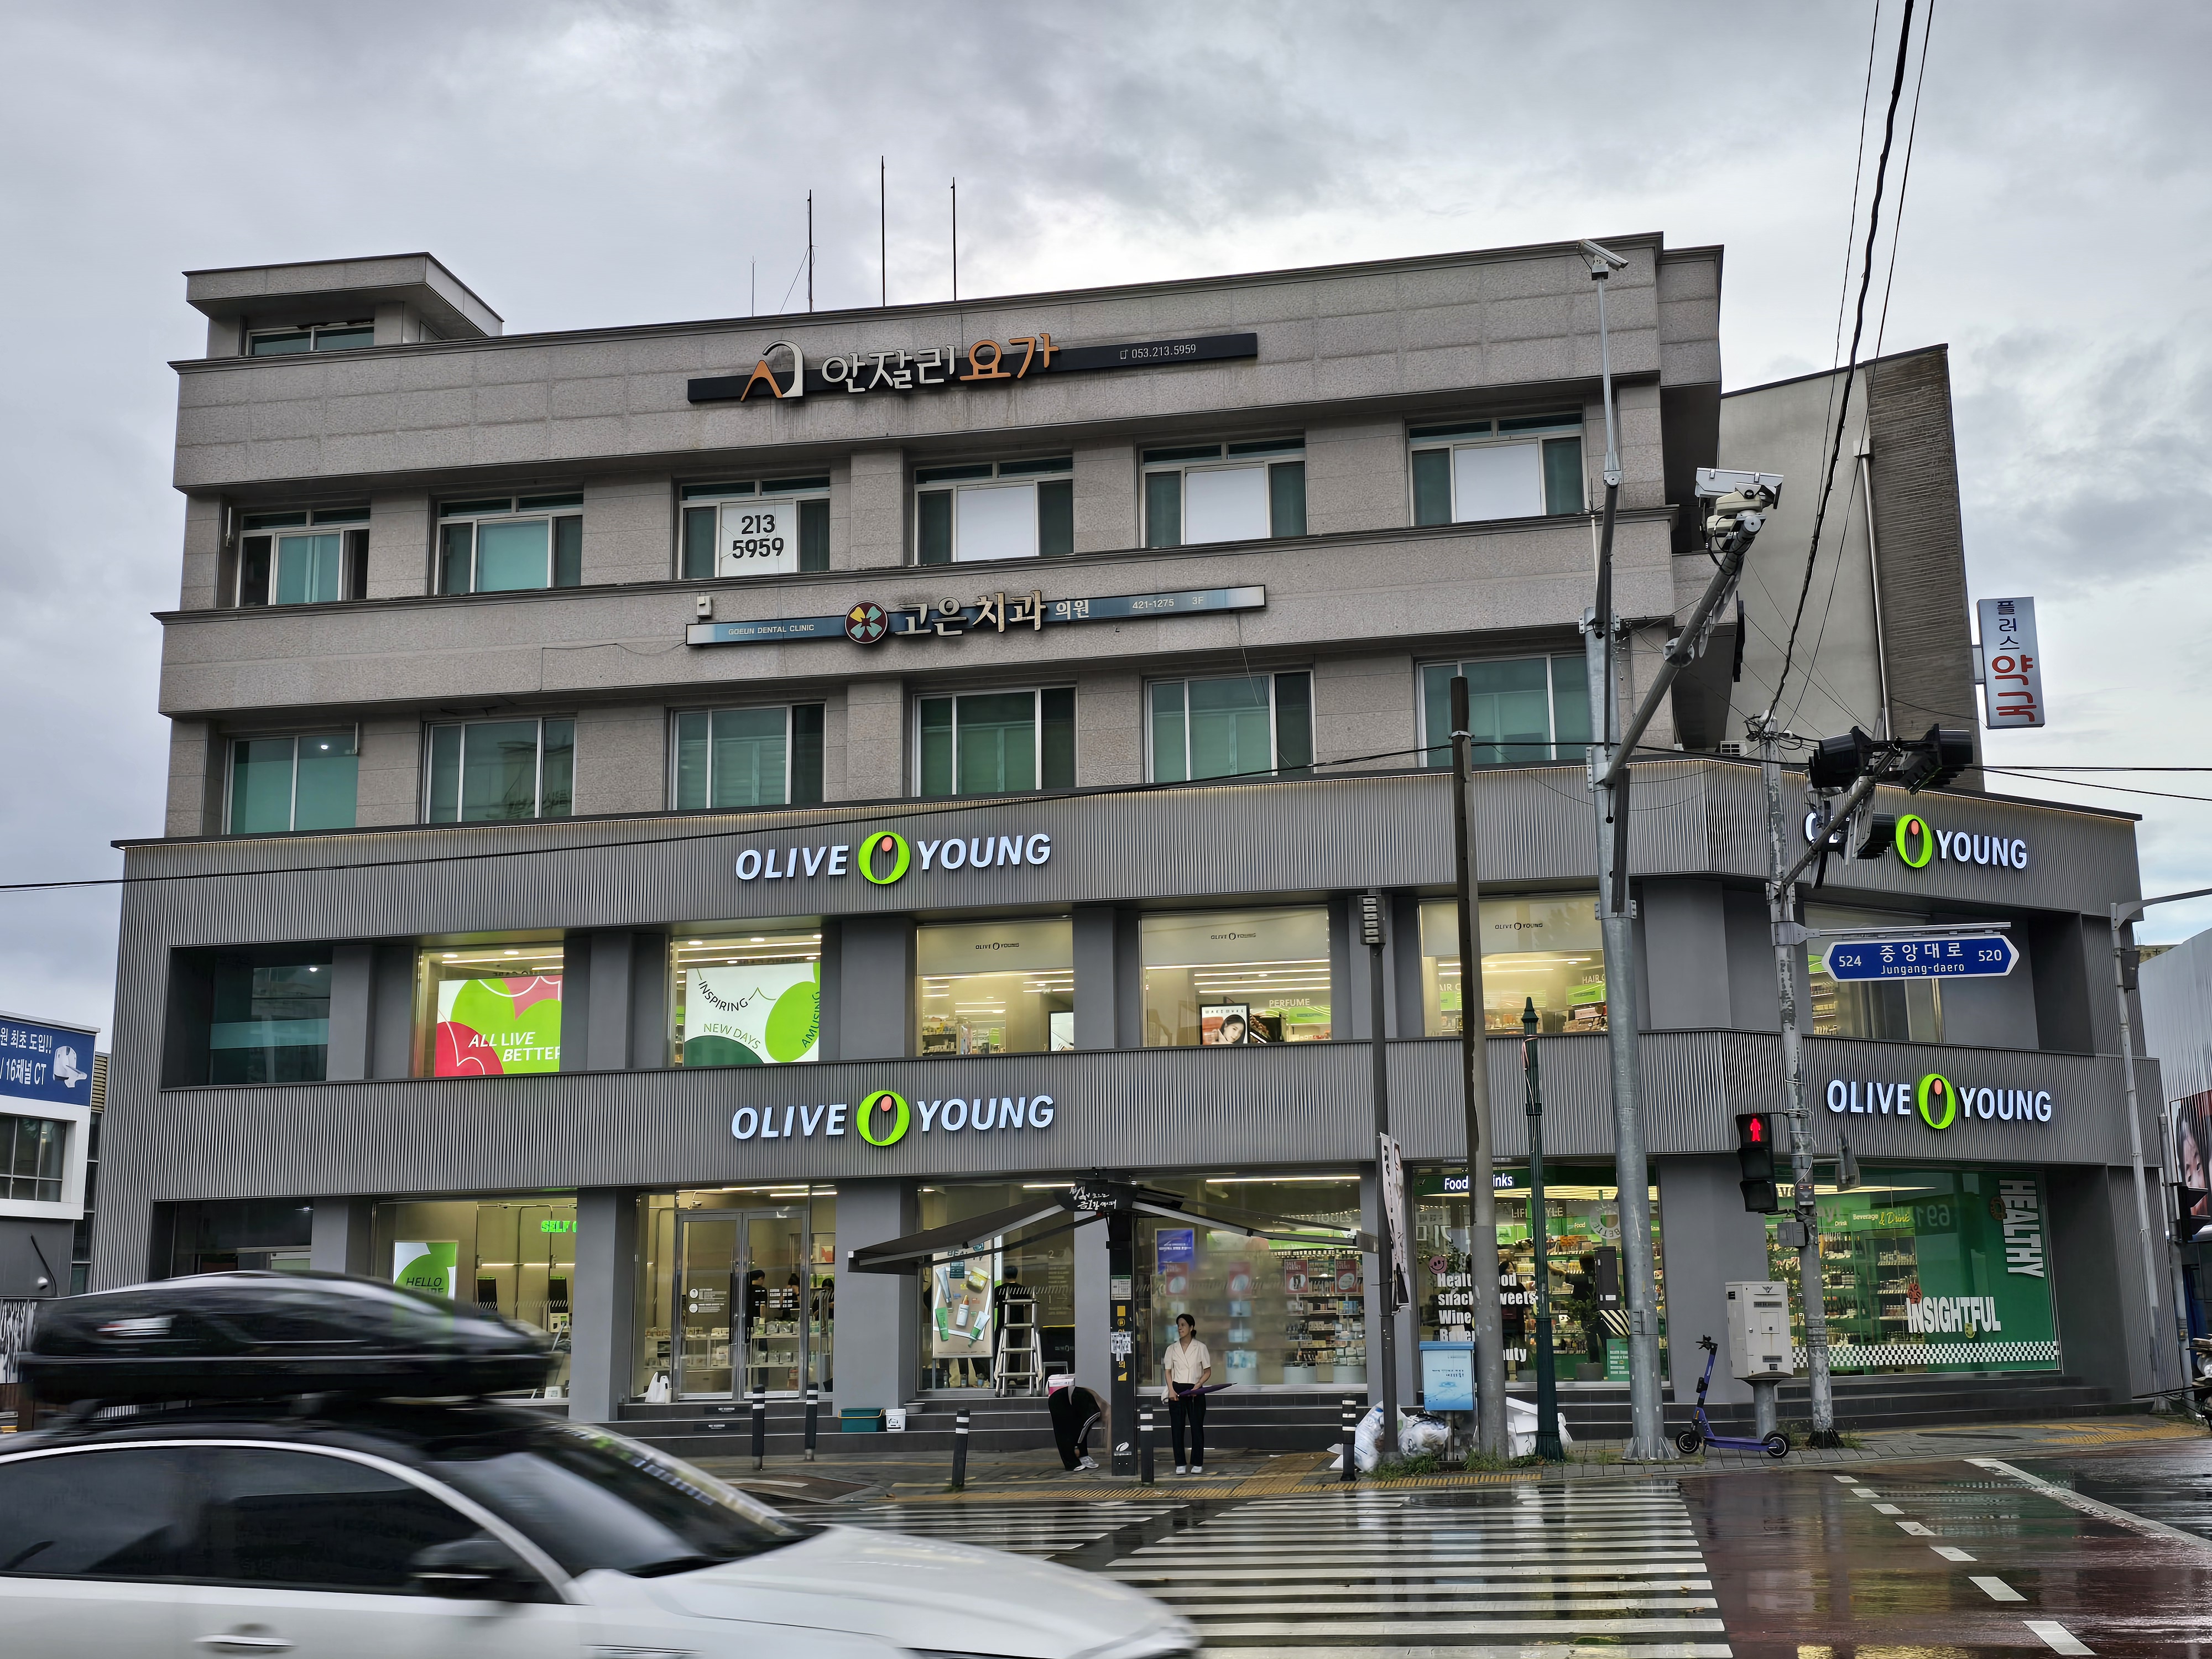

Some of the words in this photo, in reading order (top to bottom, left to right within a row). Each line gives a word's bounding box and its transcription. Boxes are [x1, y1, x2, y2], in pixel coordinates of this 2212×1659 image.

[1131, 344, 1196, 358] 053.213.5959
[741, 514, 775, 534] 213
[732, 537, 784, 559] 5959
[1132, 598, 1175, 609] 421-1275
[1192, 596, 1204, 606] 3F
[894, 589, 1046, 637] 고은치과
[1055, 599, 1090, 620] 의원
[757, 625, 787, 634] DENTAL
[790, 624, 815, 633] CLINIC
[735, 844, 849, 880] OLIVE
[917, 833, 1051, 871] YOUNG
[1936, 829, 2028, 869] YOUNG
[1839, 956, 1862, 967] 524
[1880, 943, 1963, 963] 중앙대로
[1978, 950, 2002, 962] 520
[1881, 963, 1965, 975] Jungang-daero
[698, 980, 748, 1011] INSPIRING
[1269, 998, 1310, 1008] PERFUME
[10, 1030, 27, 1048] 최초
[29, 1034, 52, 1054] 도입!!
[468, 1034, 497, 1048] ALL
[501, 1031, 536, 1046] LIVE
[704, 1023, 732, 1035] NEW
[733, 1028, 761, 1049] DAYS
[6, 1058, 32, 1085] 16채널
[34, 1062, 47, 1085] CT
[1827, 1079, 1911, 1115] OLIVE
[1960, 1086, 2052, 1122] YOUNG
[731, 1104, 847, 1140] OLIVE
[917, 1095, 1056, 1132] YOUNG
[1444, 1176, 1469, 1190] Food
[1493, 1173, 1513, 1187] inks
[541, 1220, 570, 1233] SELF
[1999, 1180, 2045, 1277] HEALTHY
[406, 1277, 442, 1287] HELLO
[1437, 1273, 1472, 1287] Healt
[1438, 1310, 1472, 1324] Wine
[1906, 1296, 2001, 1333] INSIGHTFUL
